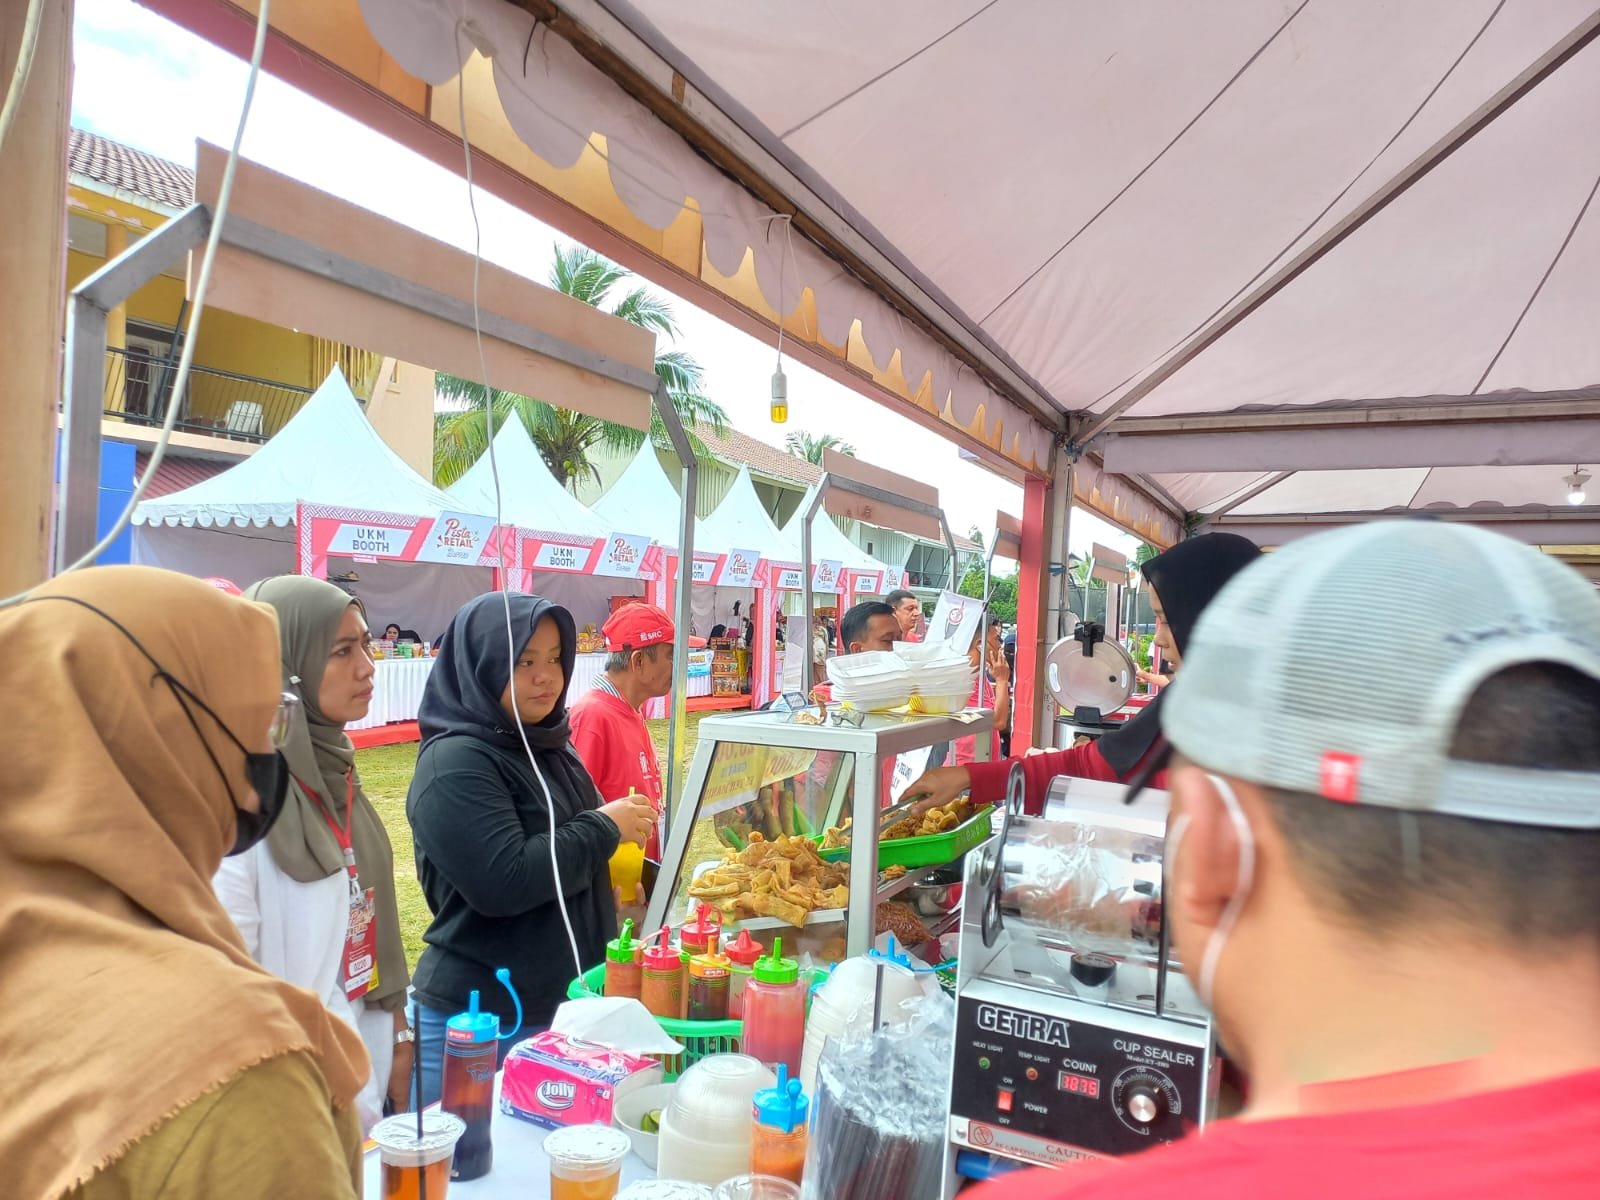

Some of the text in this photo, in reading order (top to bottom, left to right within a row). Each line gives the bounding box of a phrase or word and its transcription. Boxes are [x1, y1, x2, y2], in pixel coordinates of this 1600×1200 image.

[445, 518, 471, 538] Pesta
[357, 528, 386, 541] UKM
[352, 540, 390, 553] BOOTH
[444, 537, 473, 548] RETAIL
[550, 556, 576, 568] BOOTH
[613, 553, 634, 563] RETAIL
[693, 563, 703, 571] KM
[693, 571, 705, 579] OTH
[647, 630, 663, 640] SRC
[977, 1004, 1070, 1049] GETRA
[987, 1044, 1004, 1053] LIGHT
[1113, 1039, 1196, 1067] CUP SEALER
[1034, 1055, 1051, 1064] LIGHT
[1063, 1058, 1098, 1073] COUNT
[1002, 1077, 1013, 1085] ON
[544, 1081, 576, 1098] Jolly
[1024, 1102, 1048, 1114] POWER
[1046, 1144, 1101, 1161] CAUTIO
